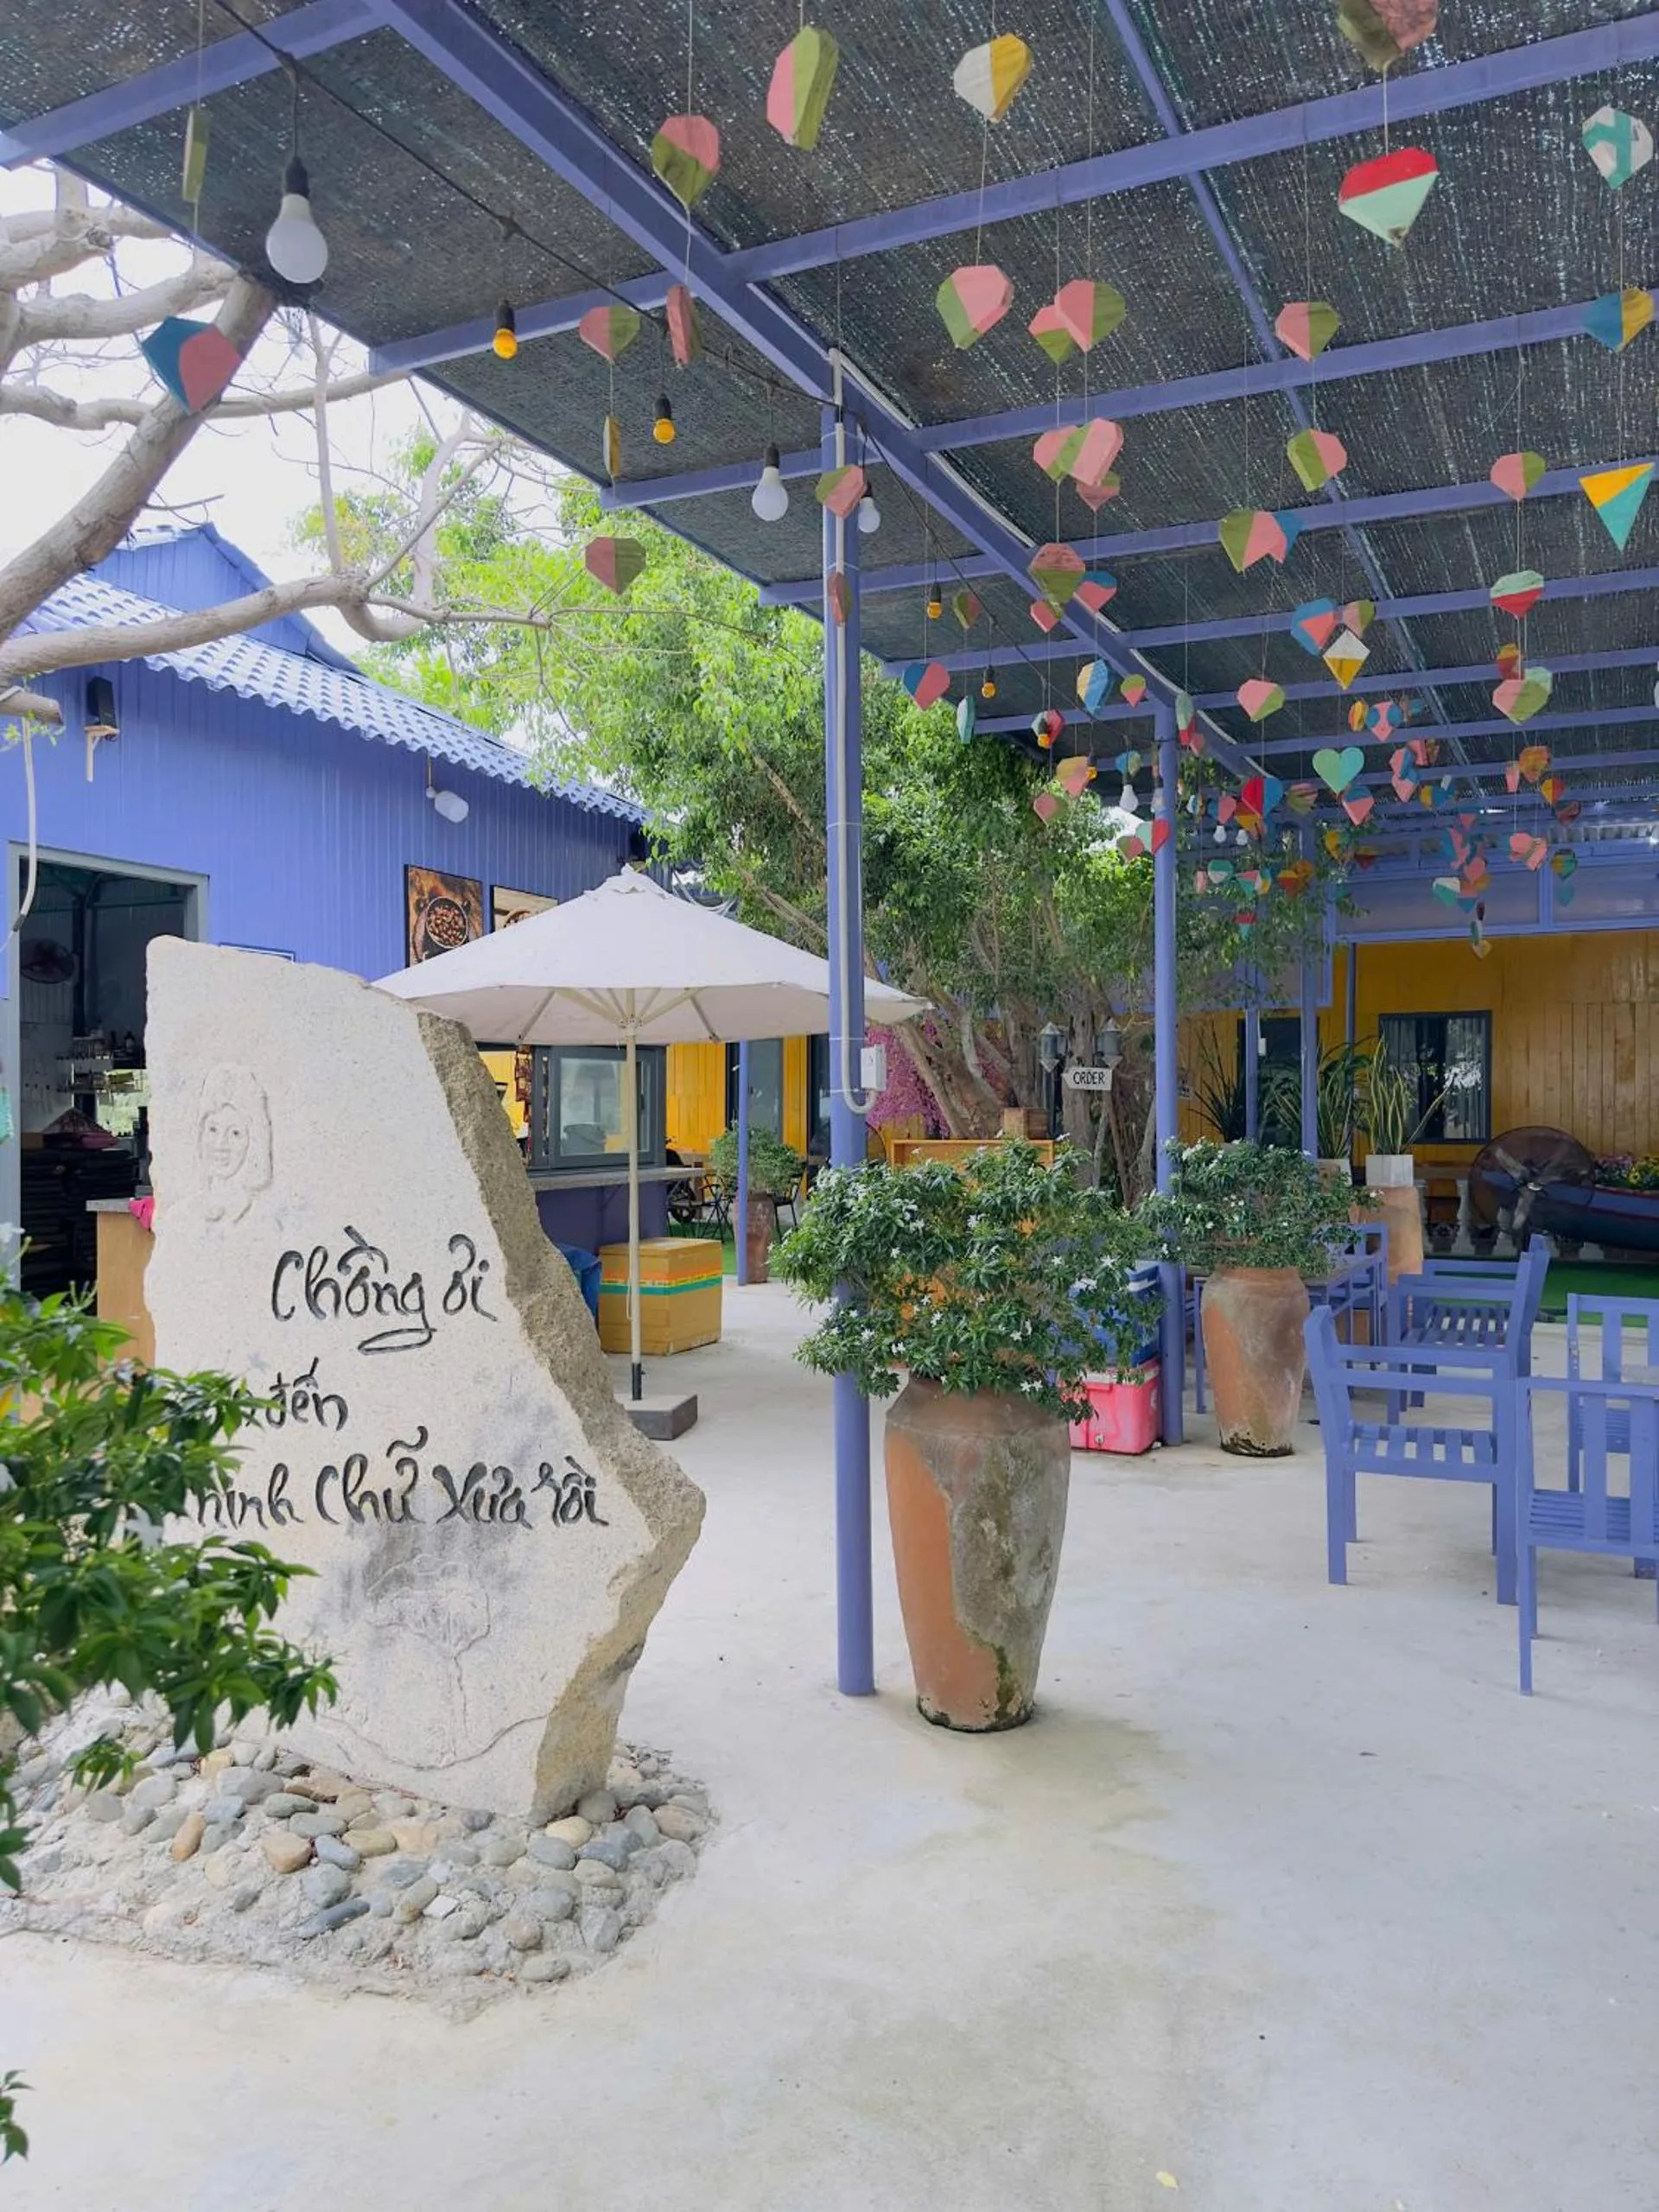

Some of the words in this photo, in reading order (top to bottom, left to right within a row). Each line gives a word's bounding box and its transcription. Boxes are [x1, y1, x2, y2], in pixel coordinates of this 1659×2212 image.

[1072, 1071, 1106, 1085] ORDER
[265, 1356, 349, 1432] đến
[432, 1461, 533, 1529] Xưa
